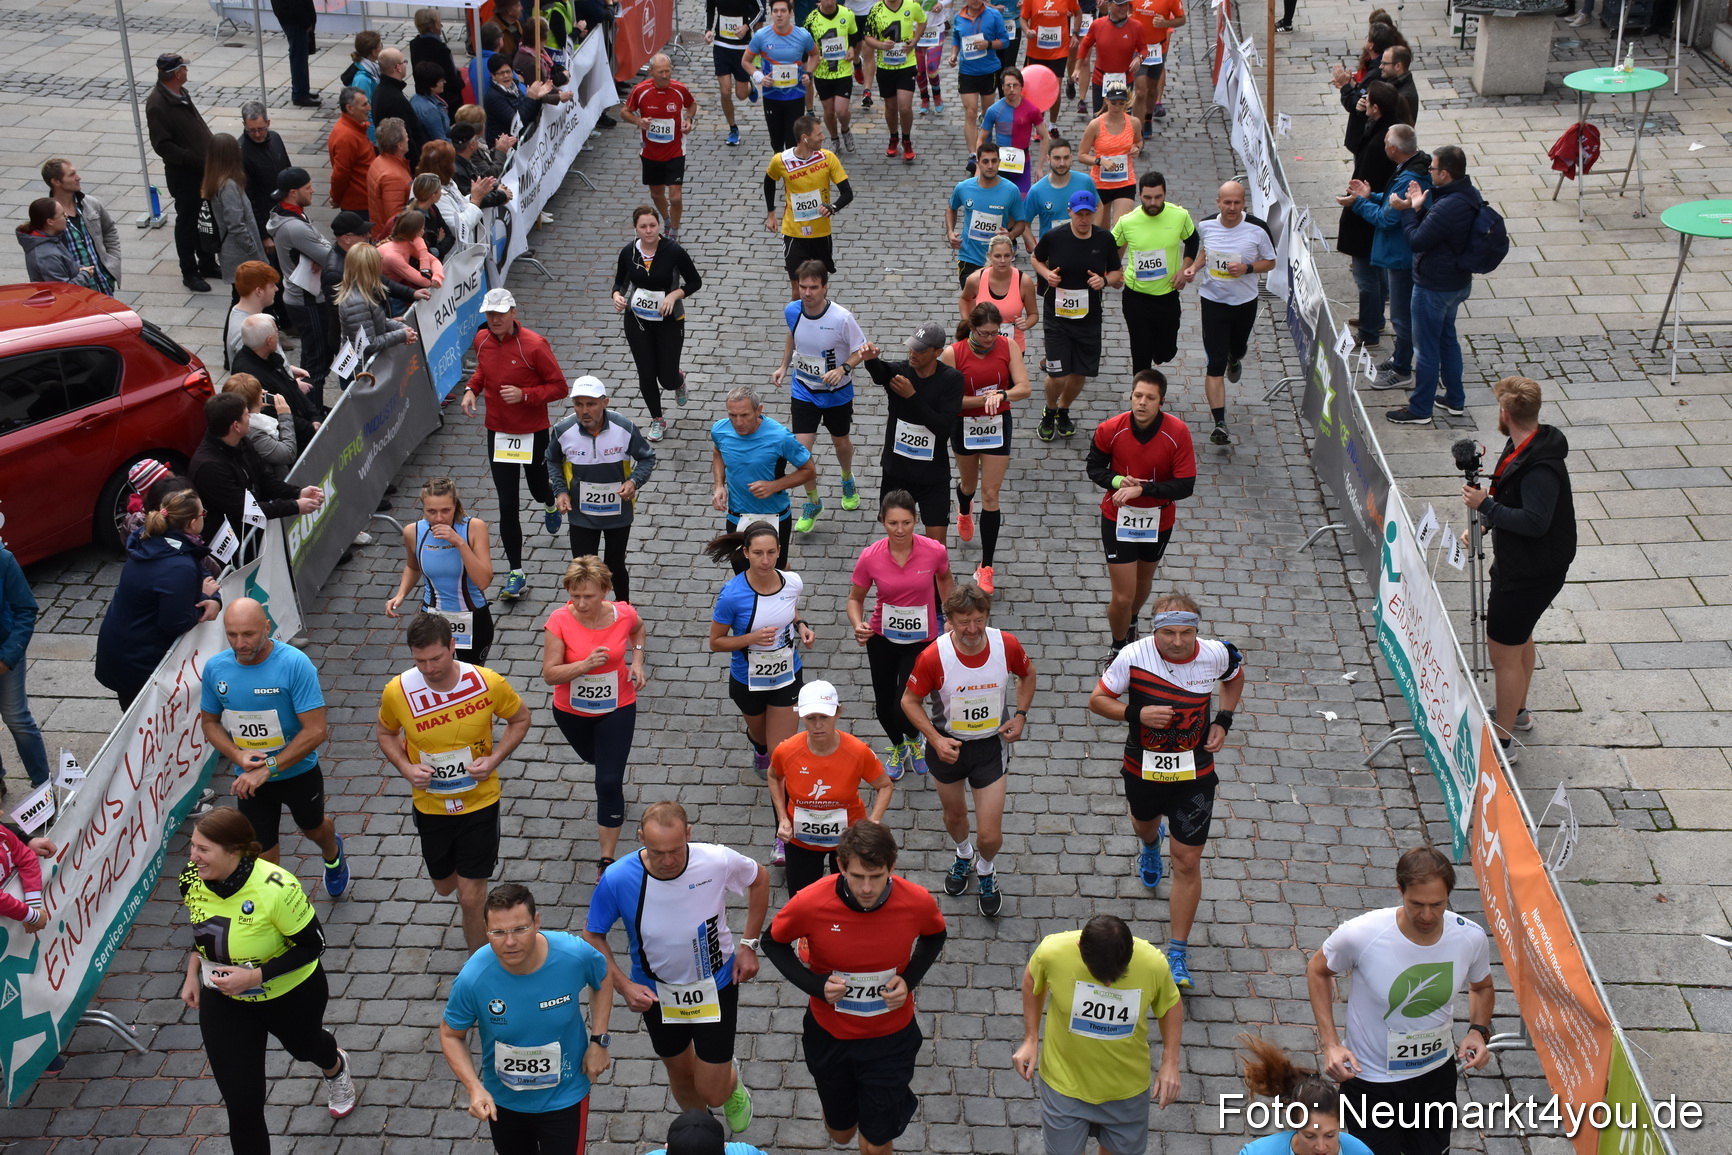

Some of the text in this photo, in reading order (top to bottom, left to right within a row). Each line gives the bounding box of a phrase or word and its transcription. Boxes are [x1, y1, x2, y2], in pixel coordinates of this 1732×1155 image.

[1041, 33, 1058, 42] 2949
[825, 43, 843, 53] 2694
[886, 49, 904, 57] 2662
[781, 72, 790, 80] 44
[650, 124, 671, 135] 2318
[1006, 153, 1016, 162] 37
[789, 161, 829, 181] MAX BÖGL
[795, 199, 818, 211] 2620
[974, 220, 997, 232] 2055
[1138, 257, 1162, 270] 2456
[1216, 260, 1229, 270] 14
[636, 298, 659, 310] 2621
[1062, 298, 1079, 309] 291
[338, 356, 352, 373] swn
[797, 361, 820, 376] 2413
[969, 425, 997, 436] 2040
[507, 438, 521, 450] 70
[901, 432, 929, 447] 2286
[586, 493, 616, 504] 2210
[1123, 515, 1153, 529] 2117
[216, 535, 232, 556] swn
[889, 616, 922, 631] 2566
[755, 660, 788, 676] 2226
[577, 685, 612, 699] 2523
[968, 682, 999, 691] KLEBL
[415, 696, 494, 733] MAX BÖGL
[963, 706, 989, 721] 168
[239, 723, 268, 738] 205
[1154, 755, 1180, 770] 281
[430, 761, 467, 780] 2624
[1152, 772, 1180, 782] Charly
[20, 800, 46, 823] swn
[801, 821, 840, 835] 2564
[94, 890, 144, 973] Service-Line:
[1521, 911, 1529, 927] für
[1527, 926, 1536, 942] die
[1531, 907, 1553, 956] Neumarkts
[540, 994, 571, 1009] BOCK
[672, 990, 704, 1005] 140
[1081, 1001, 1129, 1023] 2014
[1089, 1022, 1118, 1032] Thorsten
[1397, 1038, 1443, 1058] 2156
[503, 1058, 551, 1073] 2583
[1405, 1056, 1434, 1067] Christian
